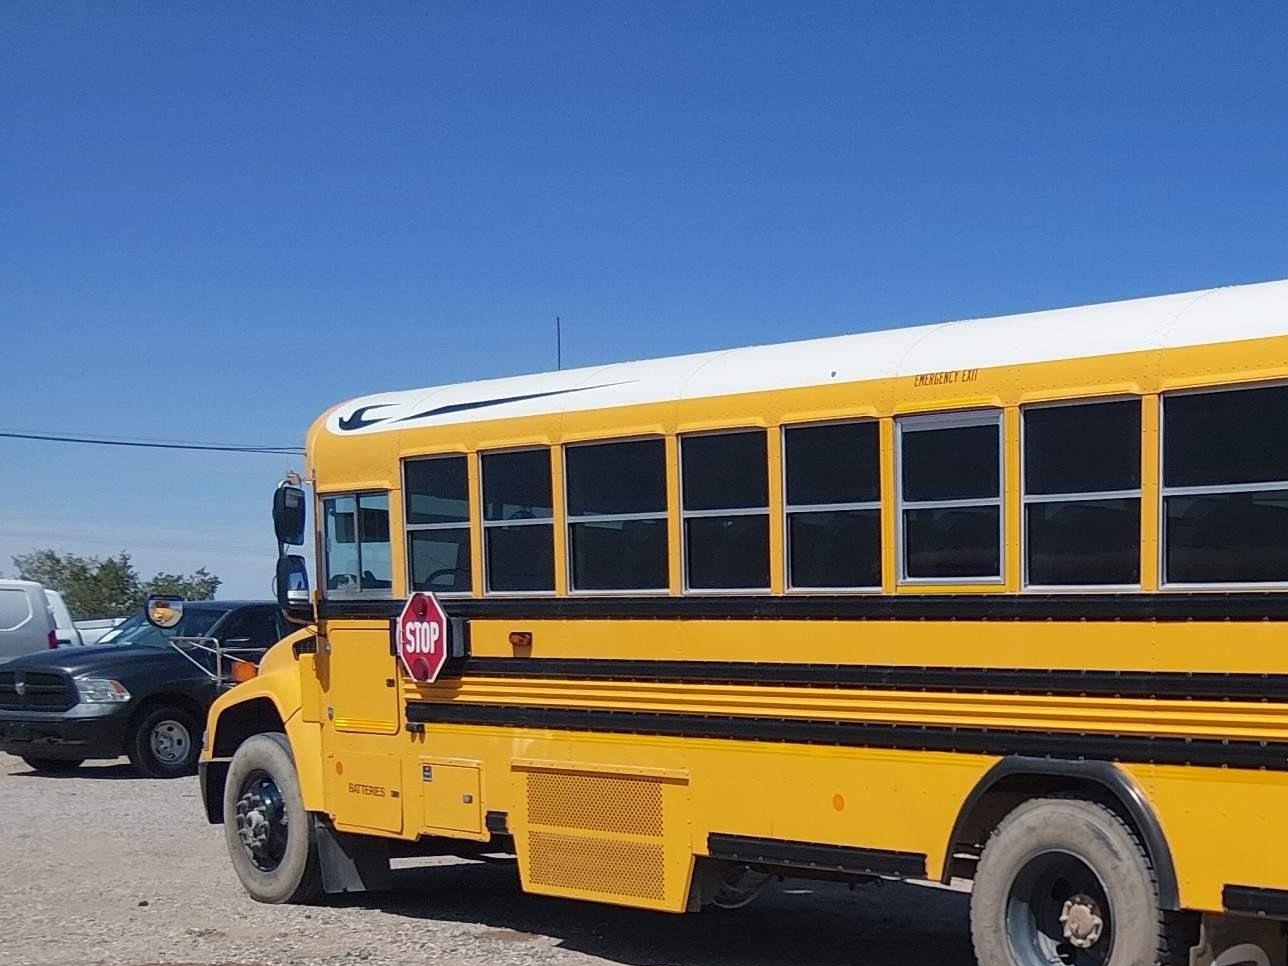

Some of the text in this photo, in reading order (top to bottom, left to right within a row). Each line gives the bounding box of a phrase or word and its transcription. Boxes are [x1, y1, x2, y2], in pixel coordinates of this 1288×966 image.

[914, 368, 979, 387] EMERGENCY EXIT
[405, 621, 440, 654] STOP
[348, 782, 386, 798] BATTERIES
